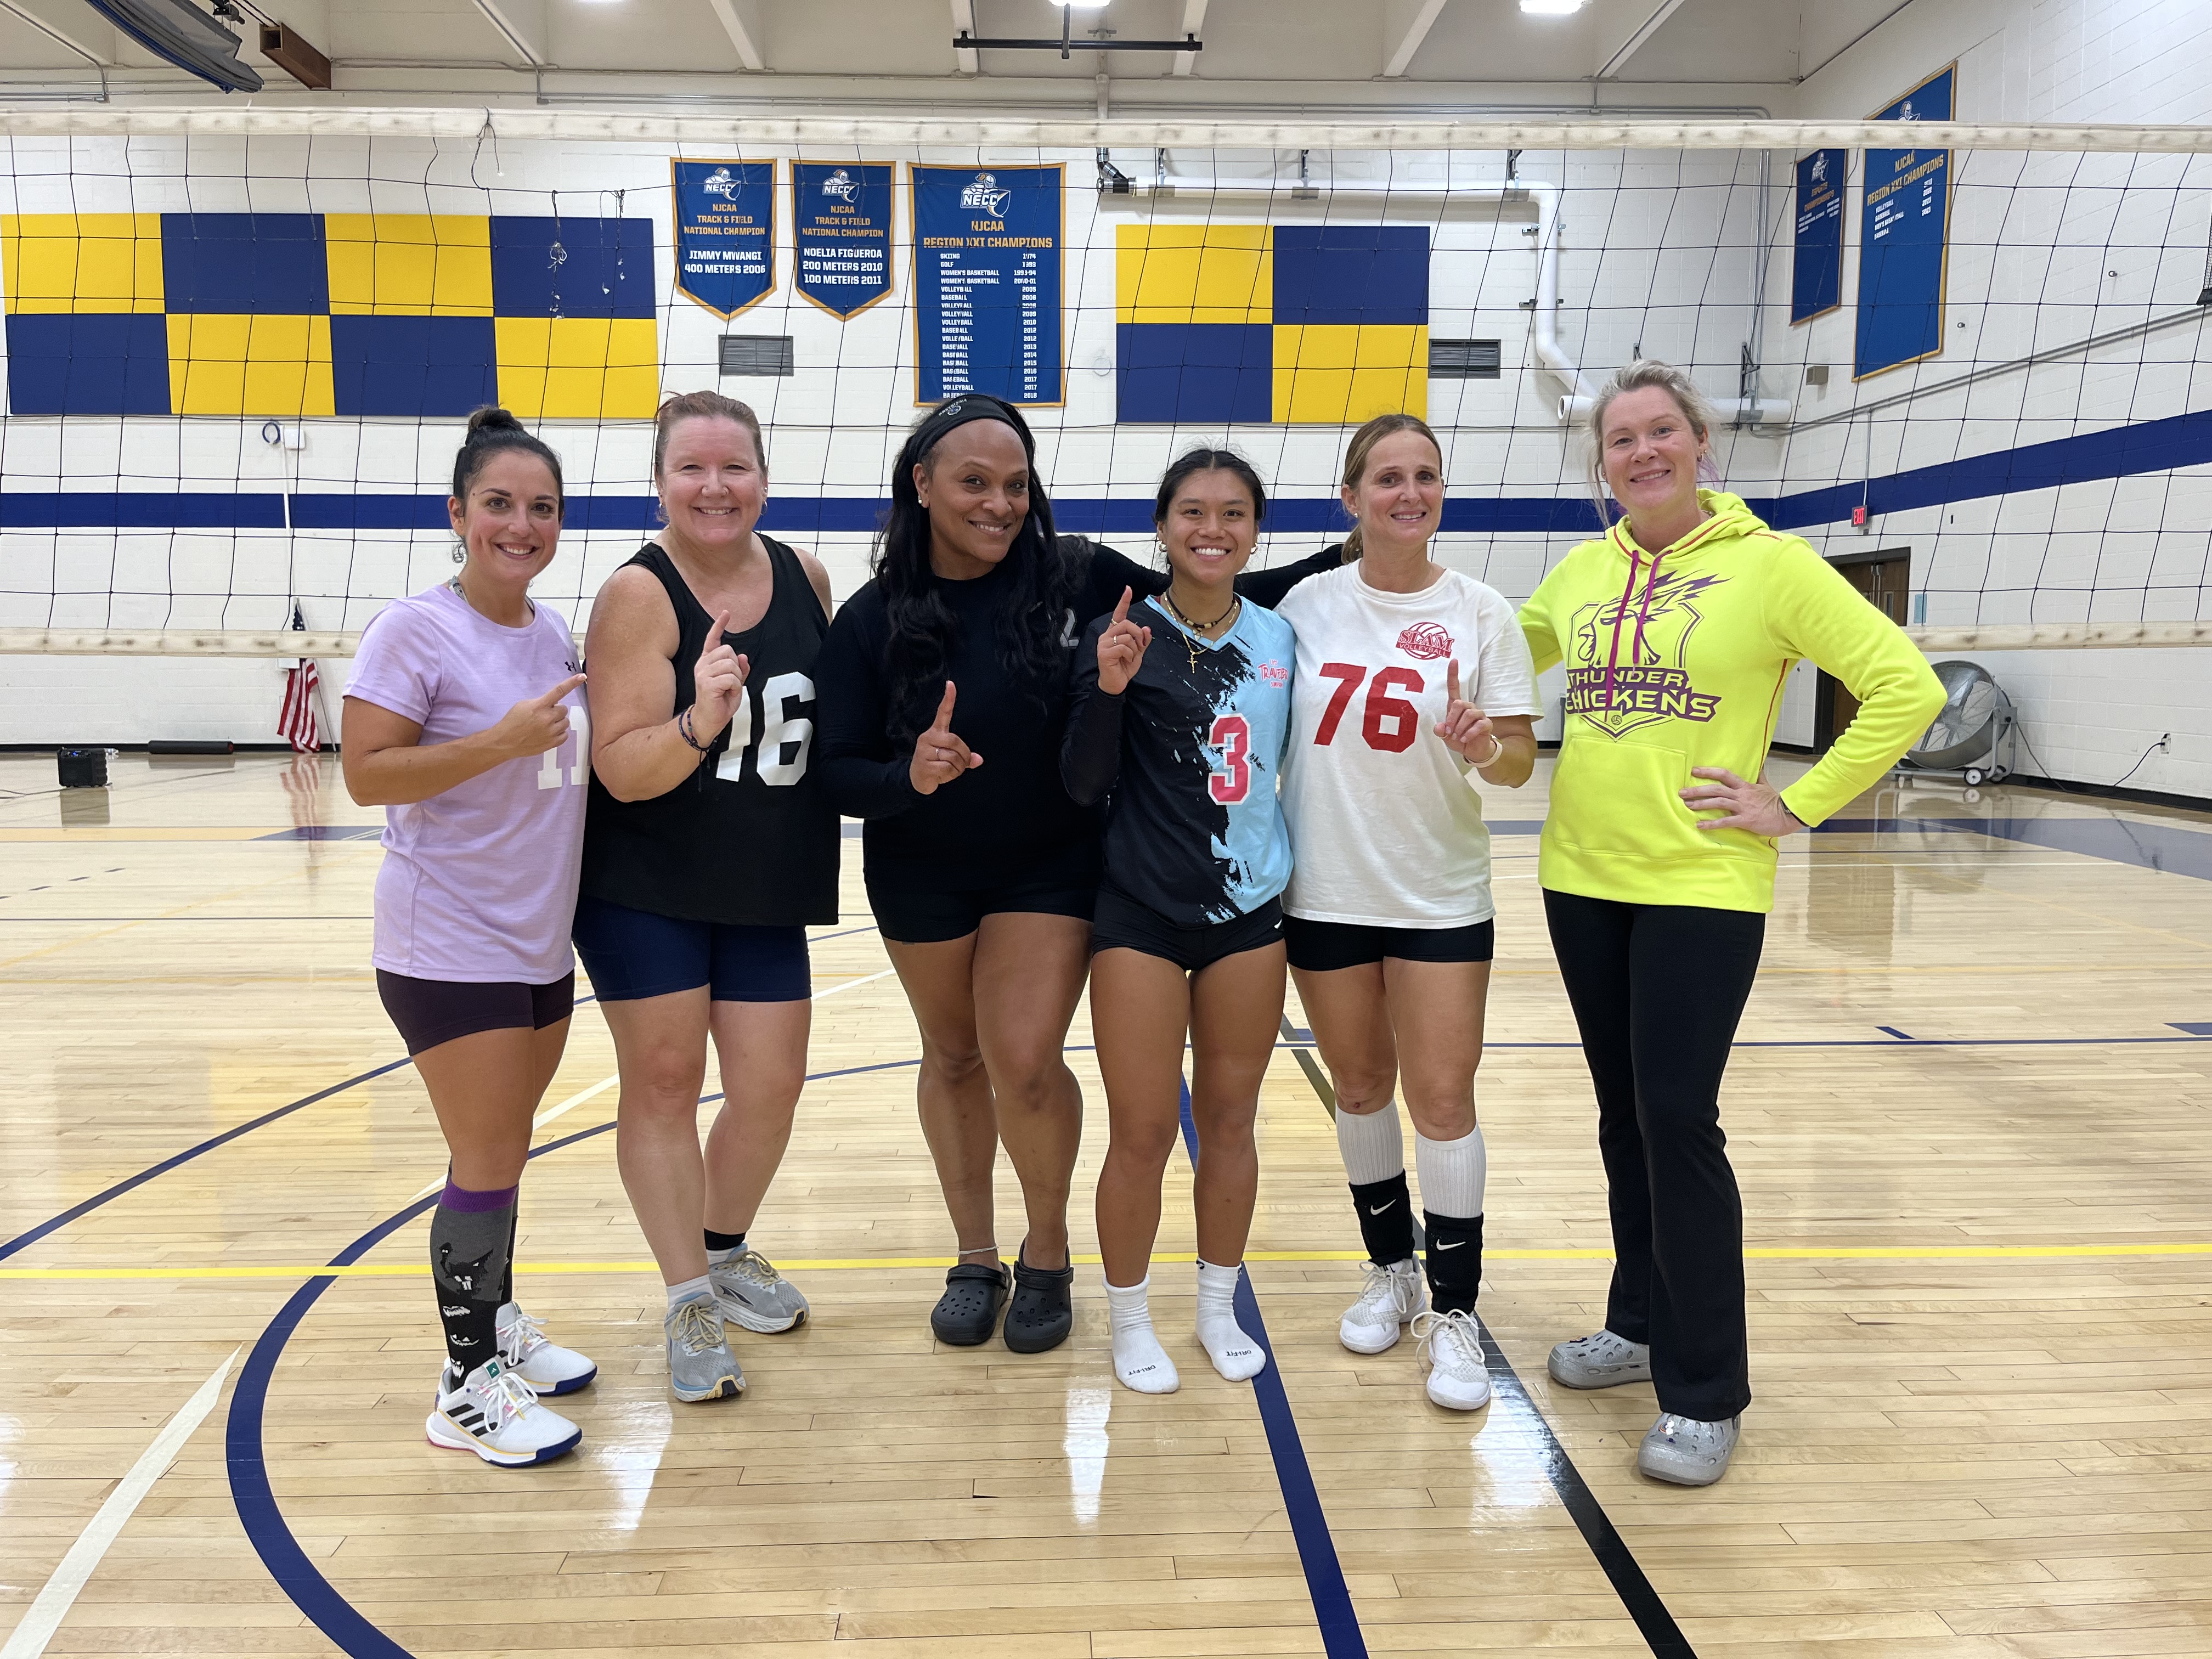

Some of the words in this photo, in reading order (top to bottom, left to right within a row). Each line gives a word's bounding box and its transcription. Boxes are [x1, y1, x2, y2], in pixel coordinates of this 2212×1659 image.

[1895, 150, 1915, 173] NJCAA
[1867, 184, 1890, 207] REGION
[1891, 177, 1903, 194] XXI
[1903, 154, 1944, 186] CHAMPIONS
[825, 185, 850, 194] NECC
[963, 194, 998, 206] NECC
[831, 206, 855, 214] NJCAA
[697, 215, 723, 223] TRACK
[731, 216, 753, 224] FIELD
[815, 217, 840, 225] TRACK
[684, 226, 723, 235] NATIONAL
[724, 227, 765, 235] CHAMPION
[971, 221, 1005, 232] NJCAA
[802, 228, 840, 236] NATIONAL
[842, 229, 883, 237] CHAMPION
[923, 238, 963, 248] REGION
[966, 238, 985, 248] XXI
[988, 238, 1053, 248] CHAMPIONS
[689, 251, 721, 260] JIMMY
[723, 251, 762, 261] MWANGI
[804, 248, 837, 257] NOELIA
[838, 249, 883, 258] FIGUEROA
[684, 264, 703, 273] 400
[705, 264, 741, 274] METERS
[743, 265, 766, 274] 2006
[803, 261, 821, 270] 200
[823, 262, 859, 271] METERS
[861, 262, 883, 272] 2010
[804, 274, 821, 284] 100
[823, 275, 859, 285] METERS
[861, 275, 882, 285] 2011
[1398, 630, 1455, 652] SLAM
[1399, 643, 1447, 657] VOLLEYBALL
[1567, 670, 1684, 687] THUNDER
[1313, 663, 1425, 753] 76
[1566, 688, 1714, 718] CHICKENS
[1207, 713, 1251, 805] 3
[1128, 1364, 1156, 1375] DRI-FIT
